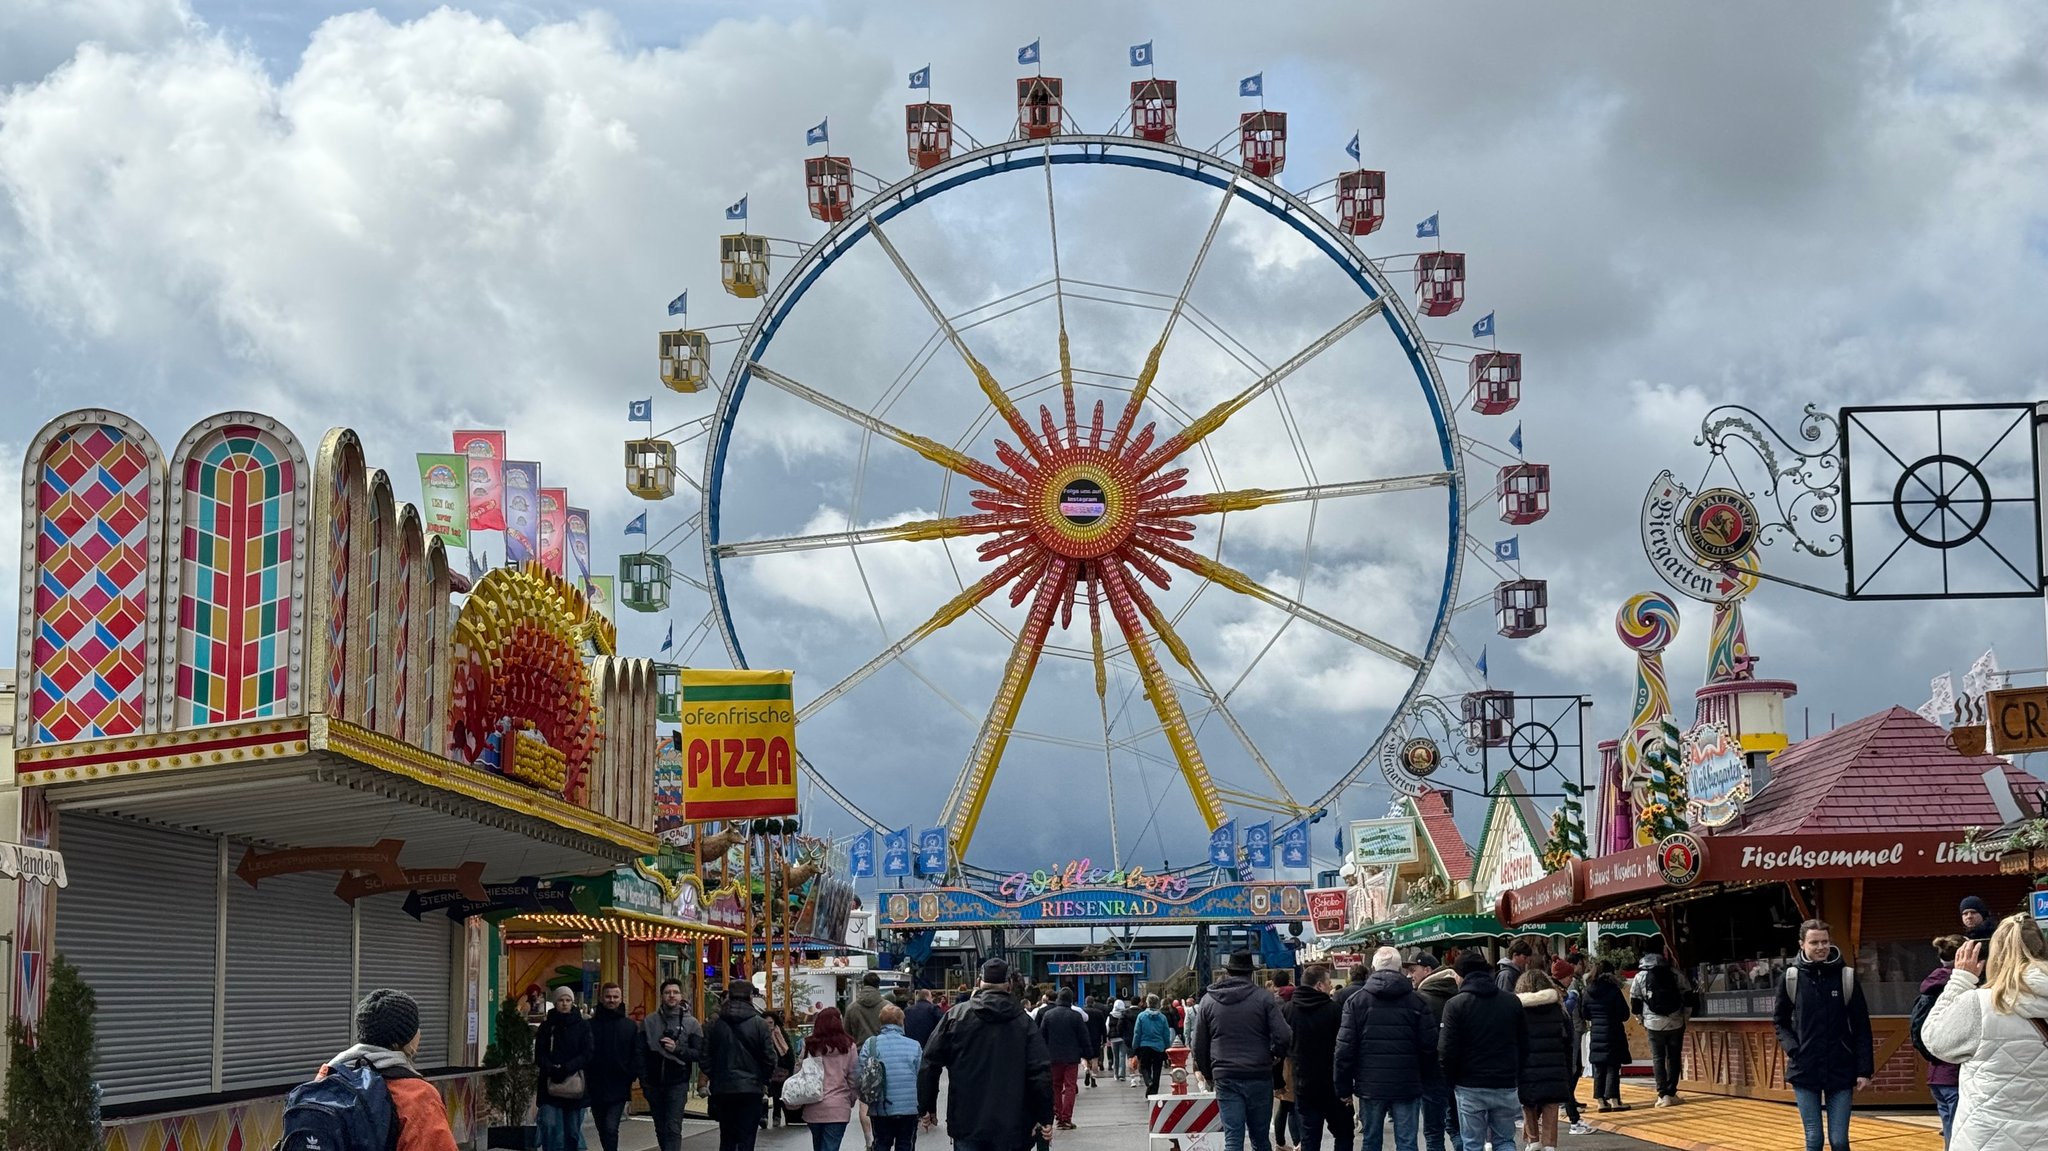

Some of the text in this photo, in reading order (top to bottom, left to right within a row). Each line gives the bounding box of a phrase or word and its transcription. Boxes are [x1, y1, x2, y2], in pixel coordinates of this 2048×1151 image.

[1699, 494, 1752, 533] PAULANER
[1649, 496, 1713, 594] Biergarten
[684, 706, 791, 725] ofenfrische
[2001, 698, 2048, 744] CR
[688, 736, 792, 788] PIZZA
[1383, 742, 1416, 793] Biergarten
[12, 846, 59, 879] Mandeln
[1659, 836, 1698, 856] PAULANER
[1740, 843, 1905, 870] Fischsemmel
[1000, 857, 1190, 902] Willenborg
[1041, 900, 1158, 917] RIESENRAD
[1058, 961, 1135, 974] FAHRKARTEN
